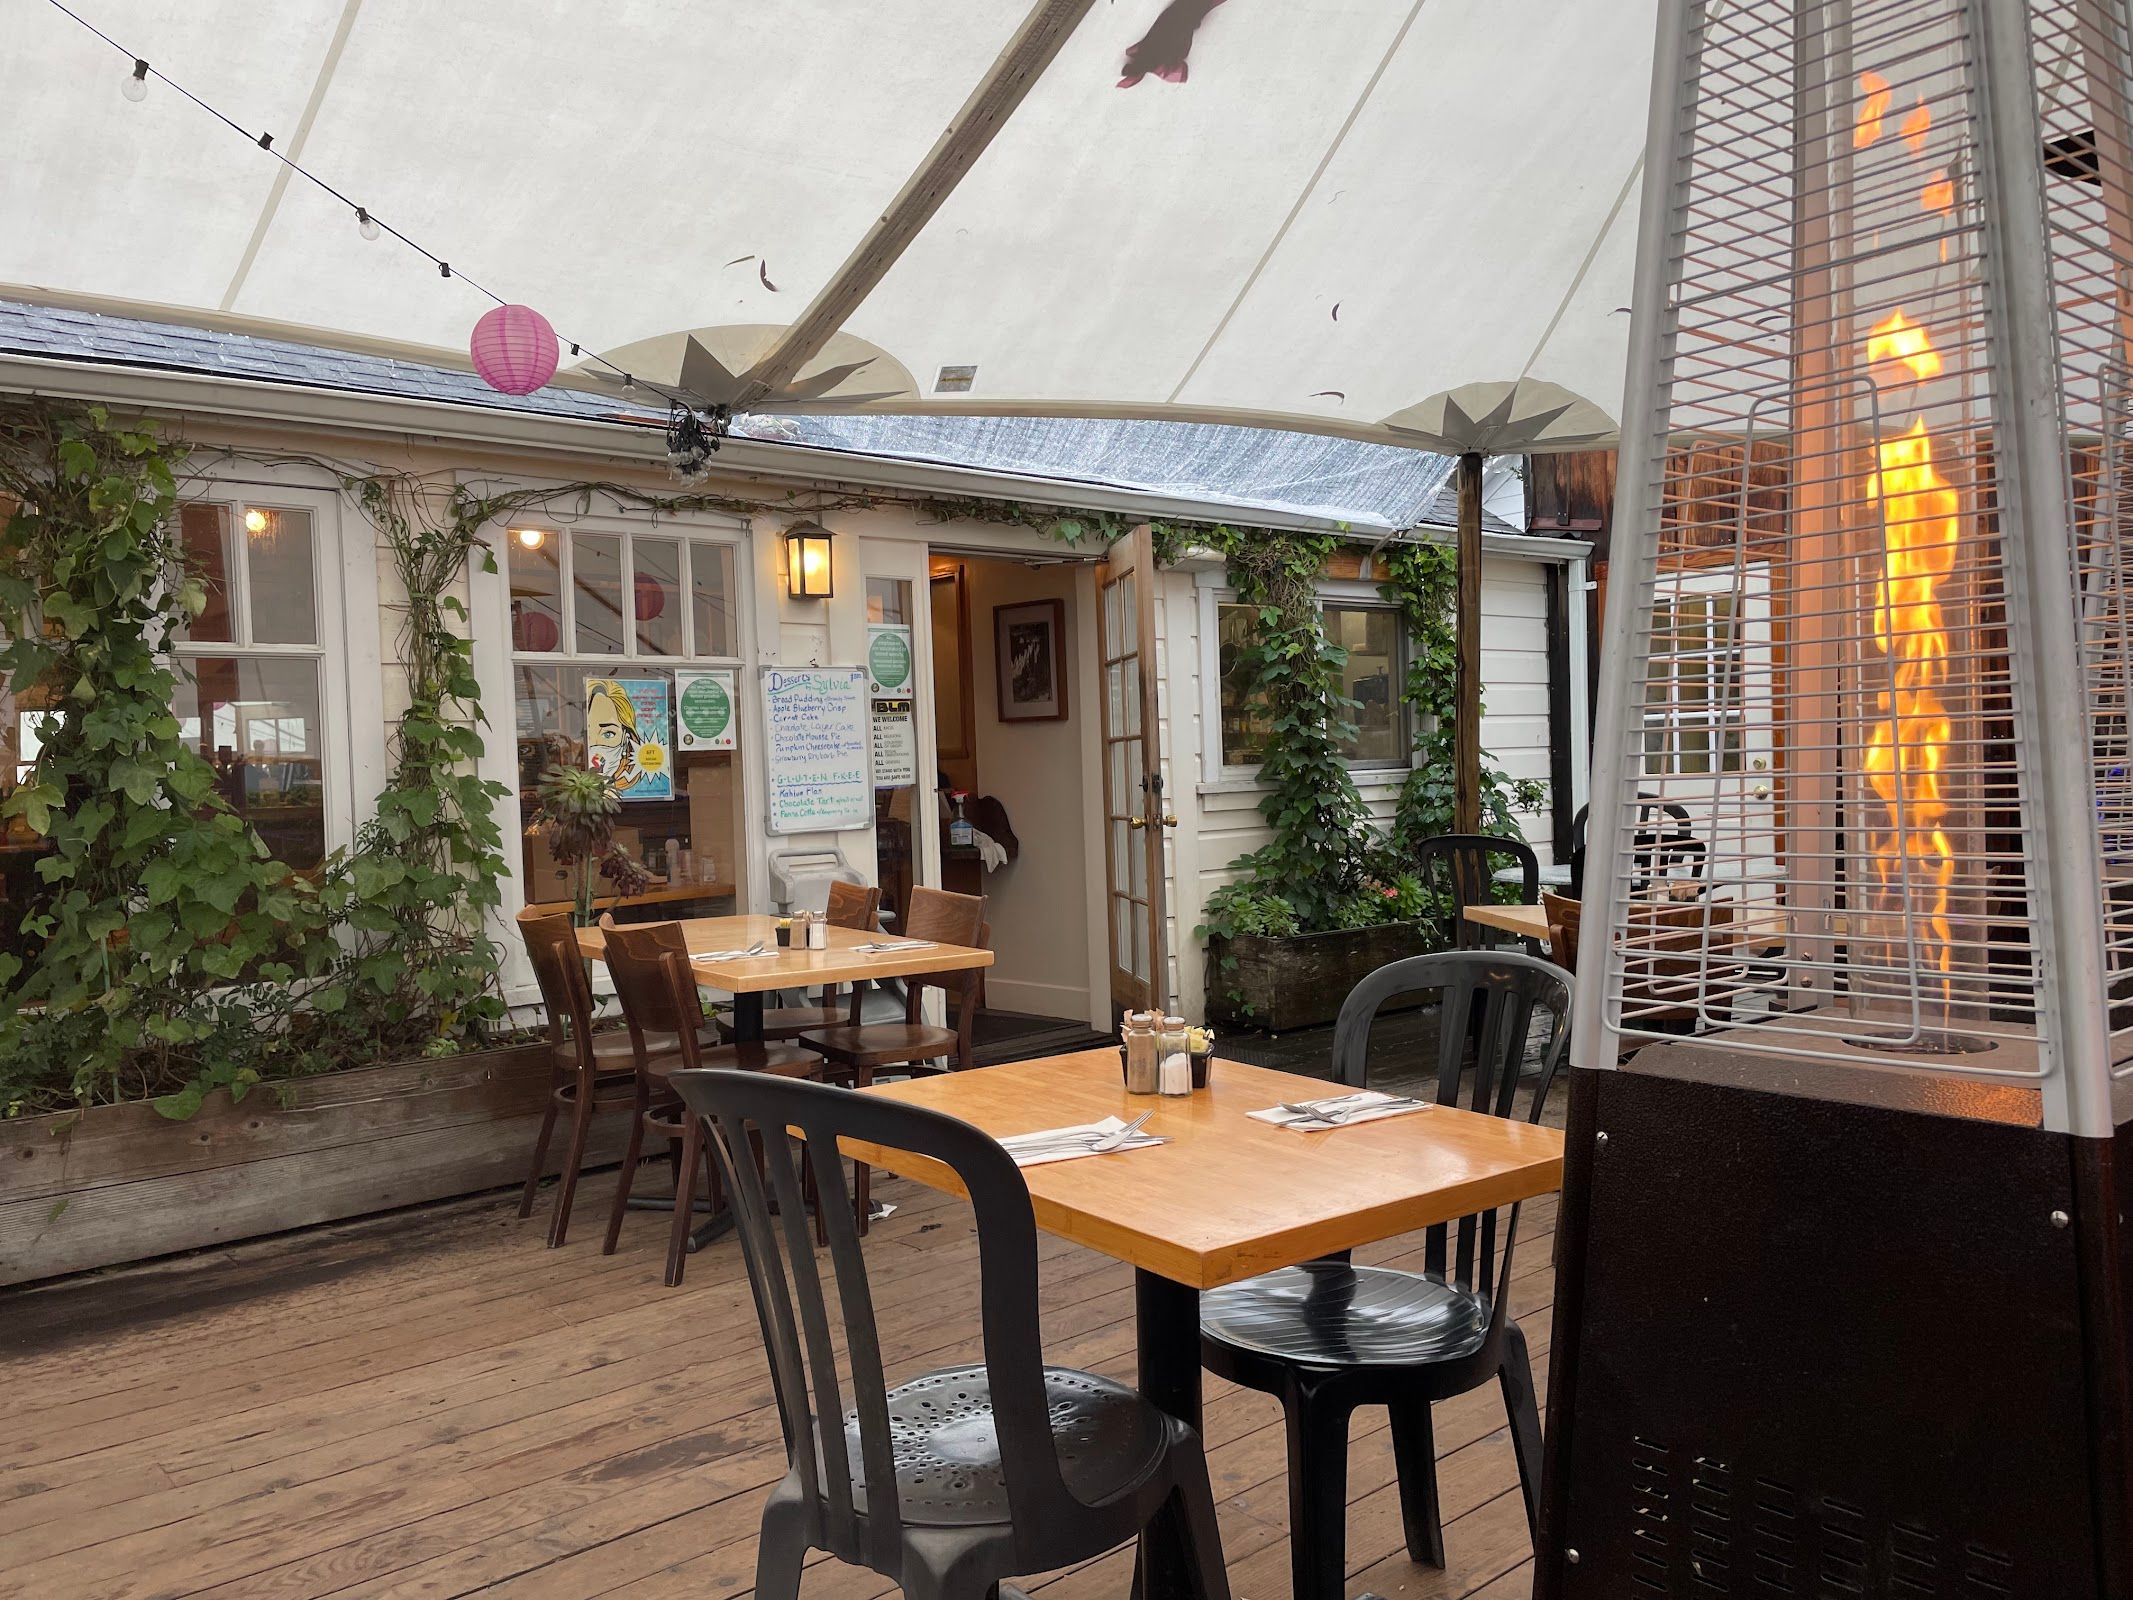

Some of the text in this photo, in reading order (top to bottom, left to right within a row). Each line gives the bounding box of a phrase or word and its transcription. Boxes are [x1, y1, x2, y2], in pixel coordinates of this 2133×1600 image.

[768, 672, 811, 692] Desserts
[812, 674, 851, 695] Sylvia
[772, 694, 793, 704] Bread
[794, 694, 824, 705] Pudding
[773, 702, 847, 715] Apple Blueberry Crisp
[876, 701, 910, 713] BLM
[801, 713, 819, 721] Cake
[881, 715, 908, 723] WELCOME
[779, 797, 815, 808] Chocolate
[817, 796, 833, 806] Tart
